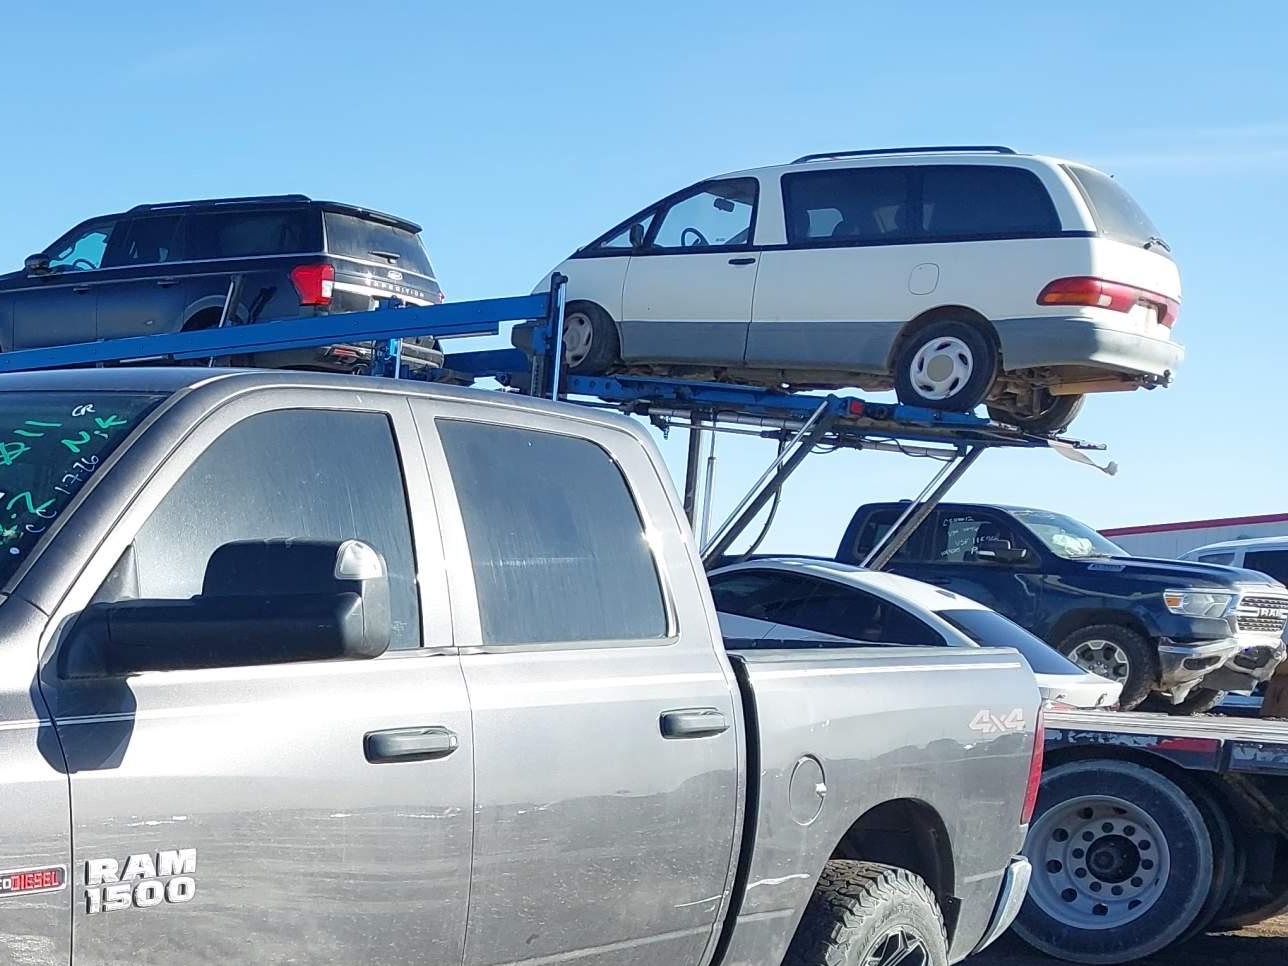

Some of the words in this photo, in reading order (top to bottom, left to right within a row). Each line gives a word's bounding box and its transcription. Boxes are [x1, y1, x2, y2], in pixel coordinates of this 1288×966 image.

[968, 707, 1027, 734] 4x4
[85, 847, 198, 886] RAM
[85, 876, 197, 914] 1500
